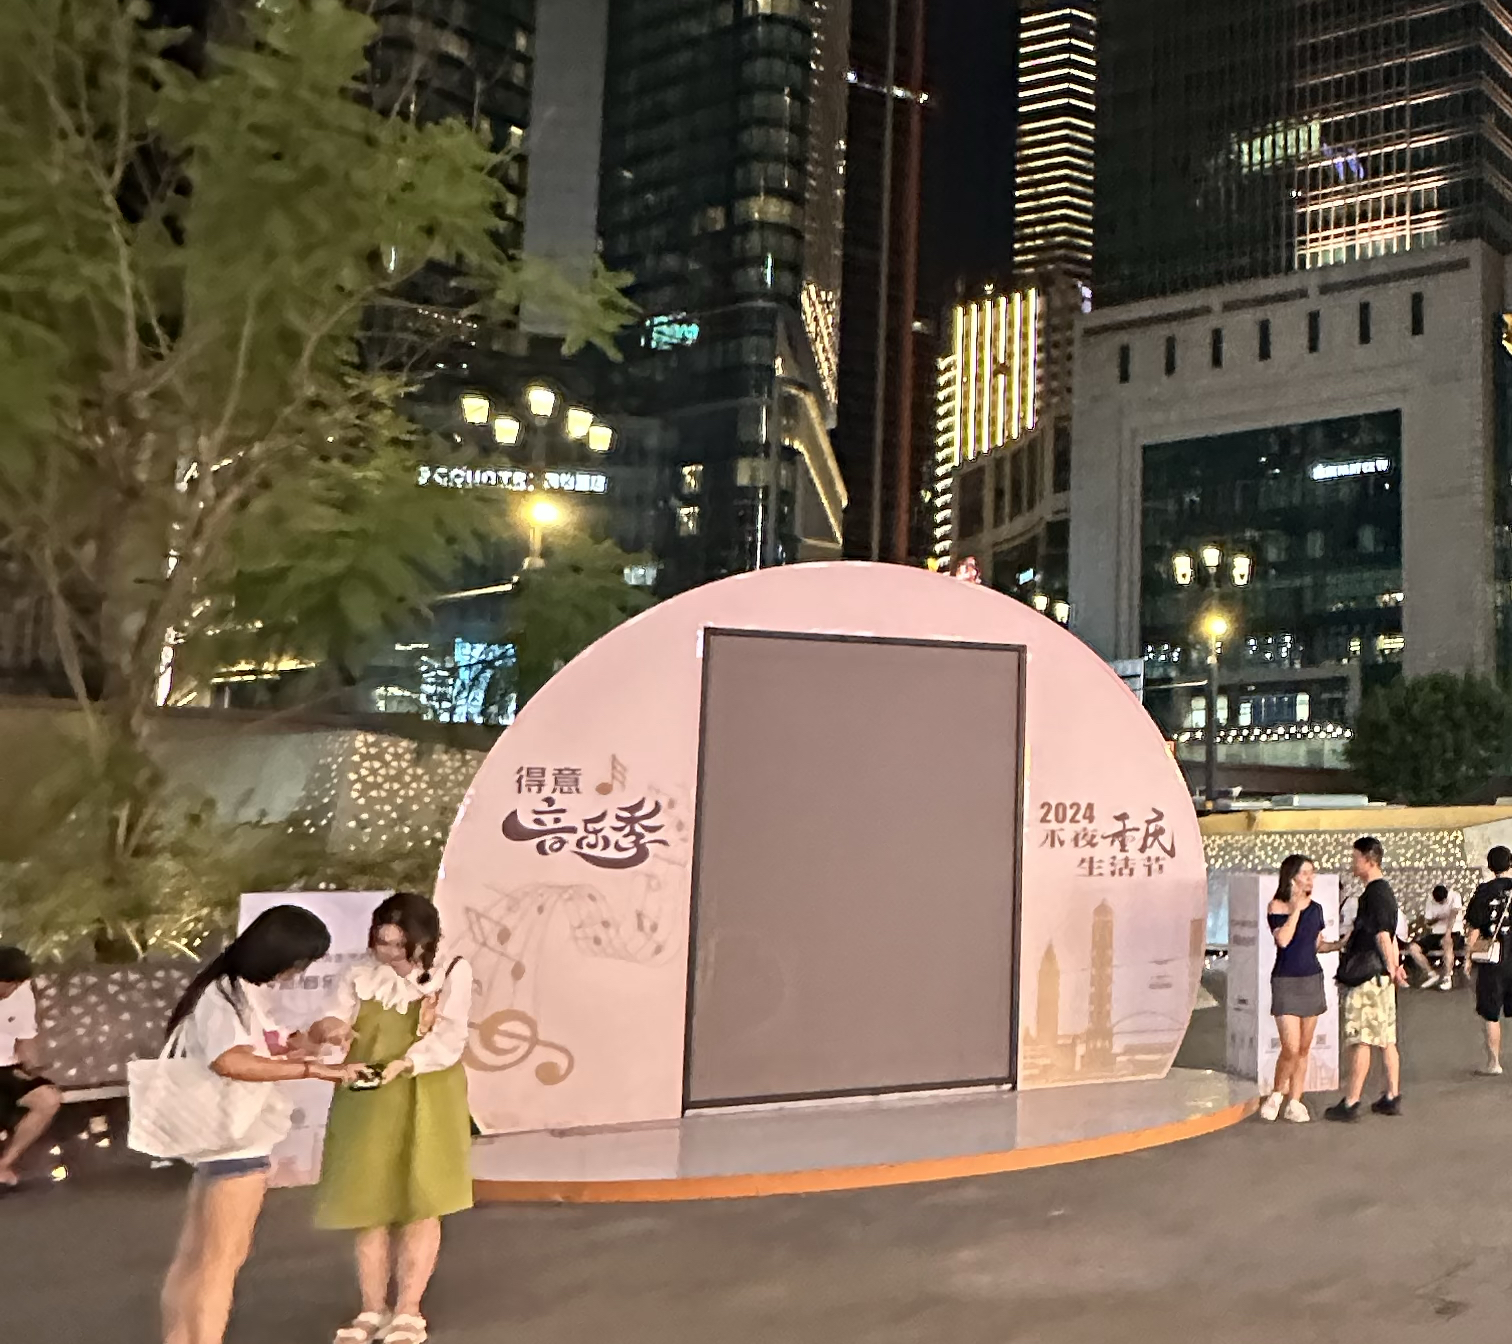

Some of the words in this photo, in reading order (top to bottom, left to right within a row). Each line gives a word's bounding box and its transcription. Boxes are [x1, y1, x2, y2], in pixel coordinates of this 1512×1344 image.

[515, 765, 583, 795] 得意
[1039, 800, 1096, 825] 2024
[501, 795, 671, 870] 音乐季
[1076, 855, 1167, 878] 生活节
